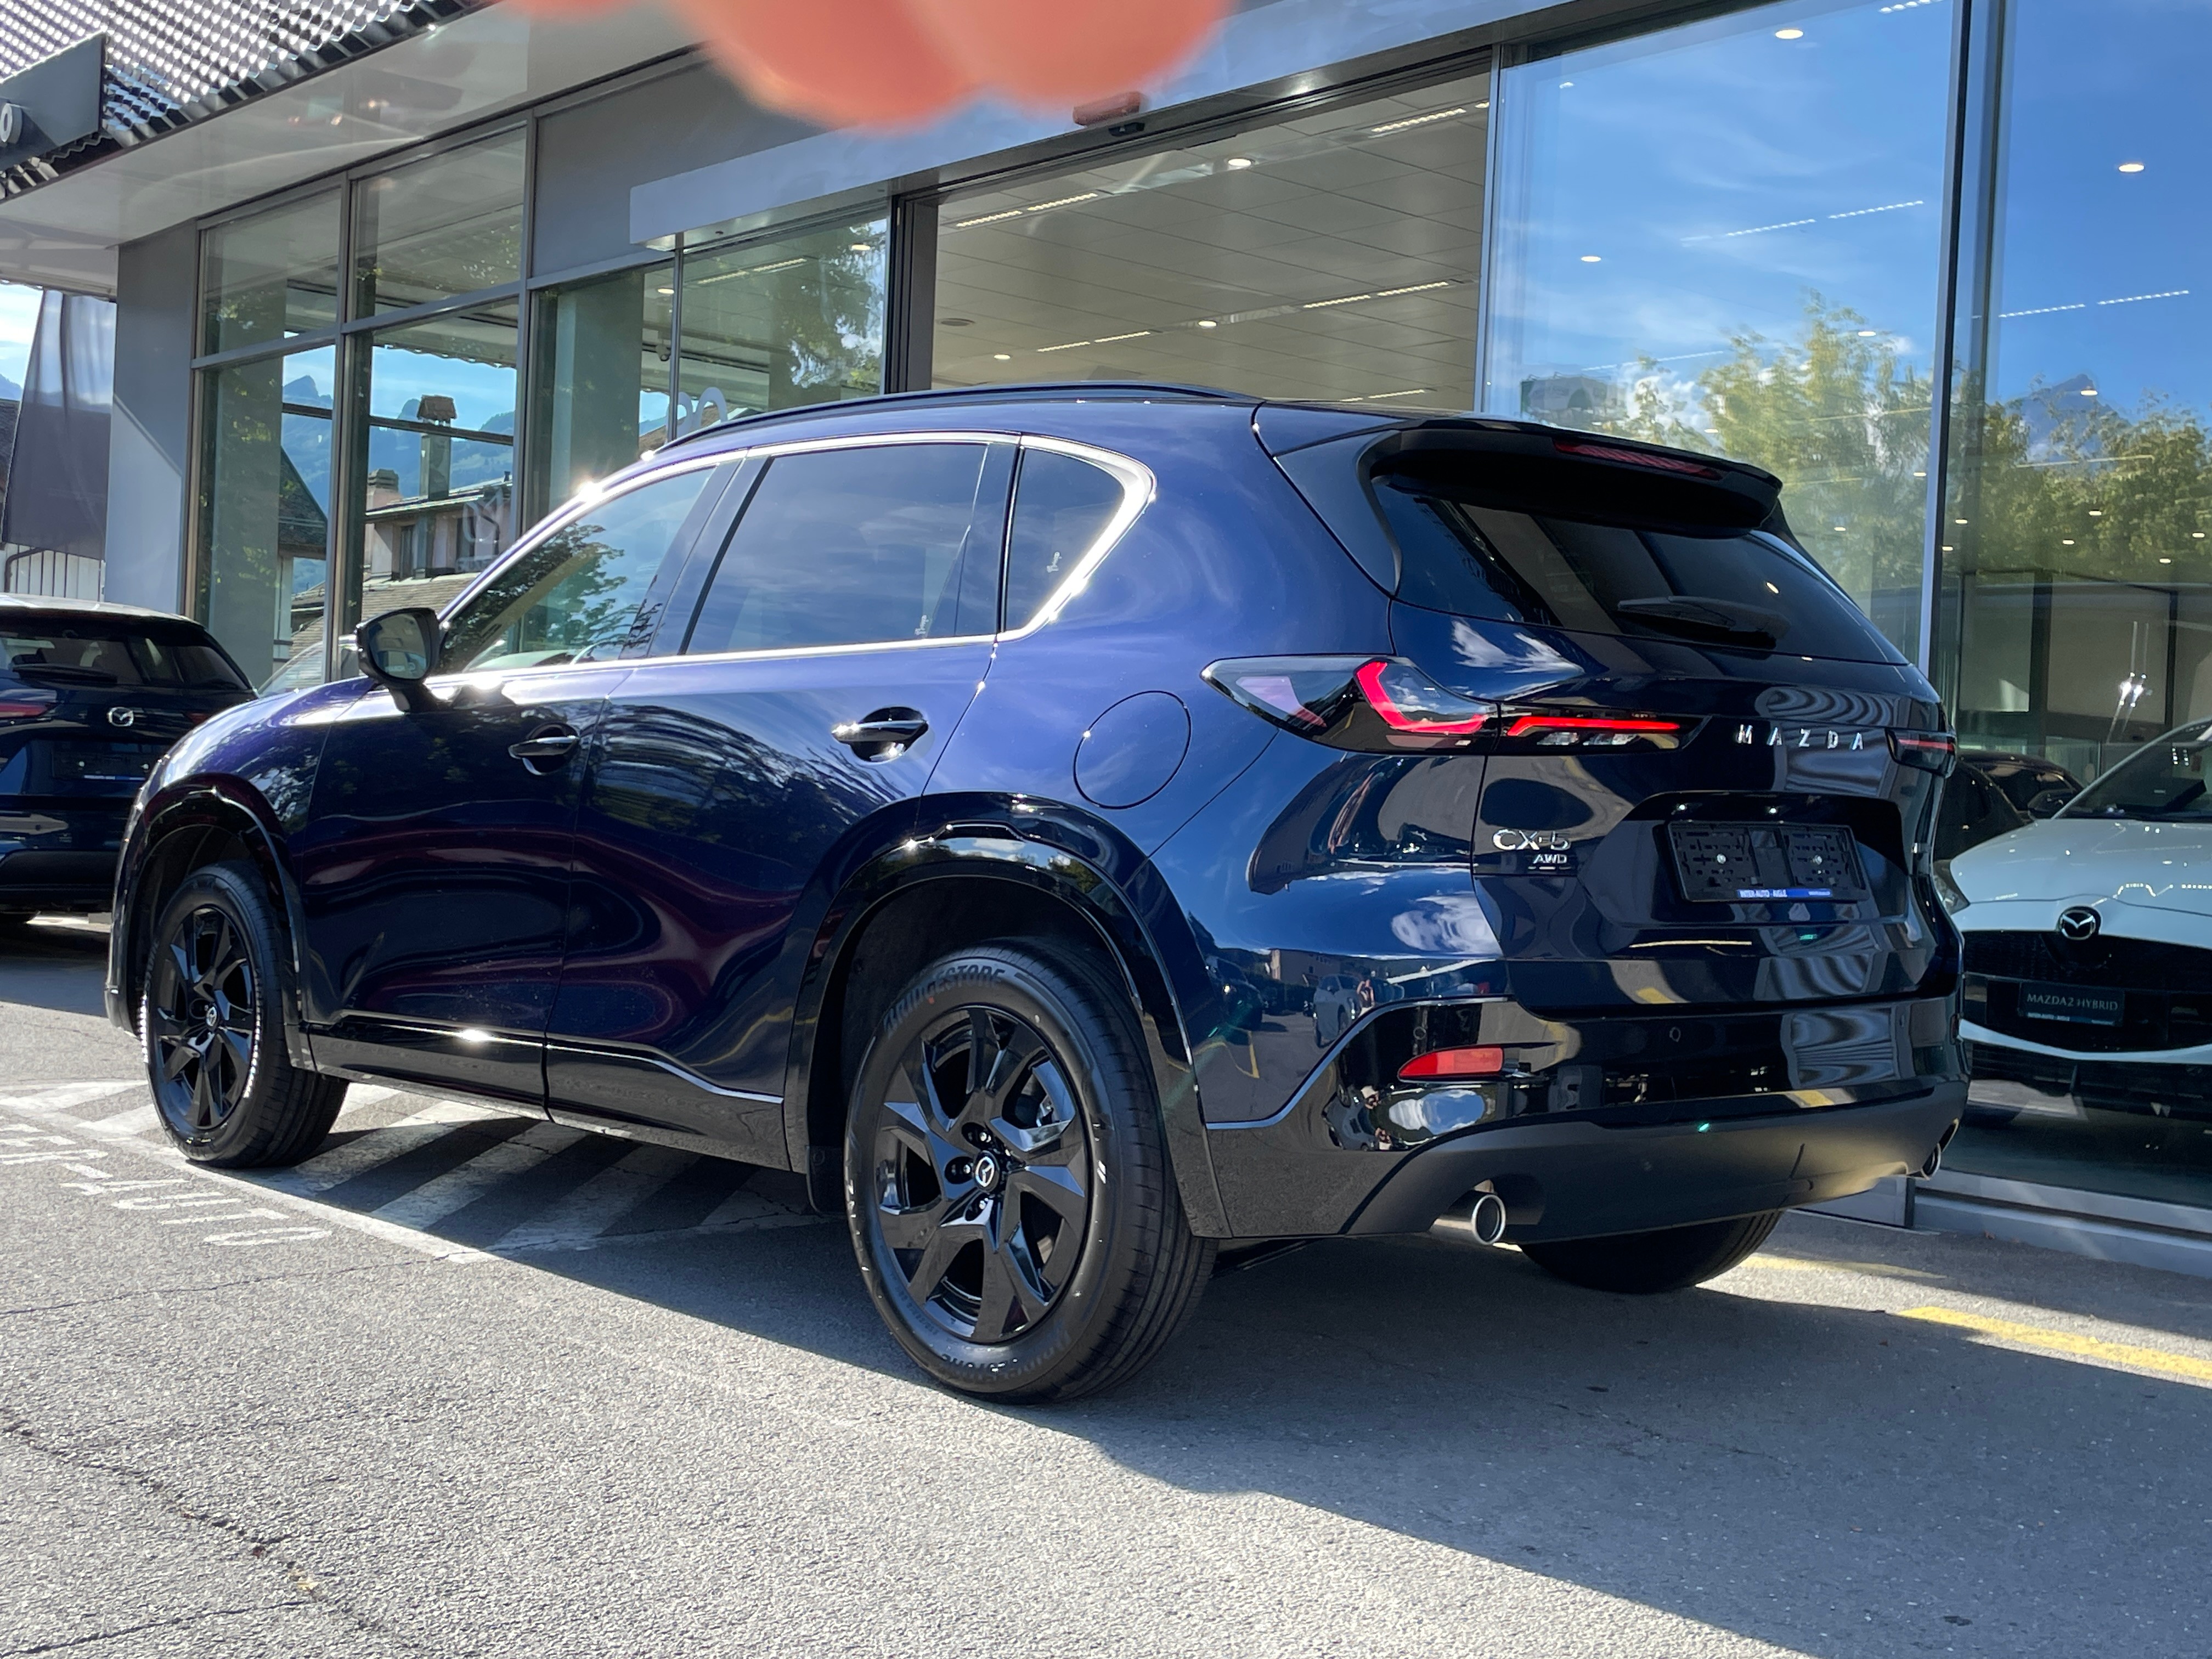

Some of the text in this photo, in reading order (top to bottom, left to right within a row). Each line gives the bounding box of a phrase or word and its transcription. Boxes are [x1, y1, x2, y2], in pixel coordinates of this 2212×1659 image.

[1736, 724, 1864, 751] MAZDA
[1492, 828, 1570, 850] CX-5
[1533, 854, 1567, 864] AWD
[2027, 993, 2118, 1011] MAZDA2 HYBRID
